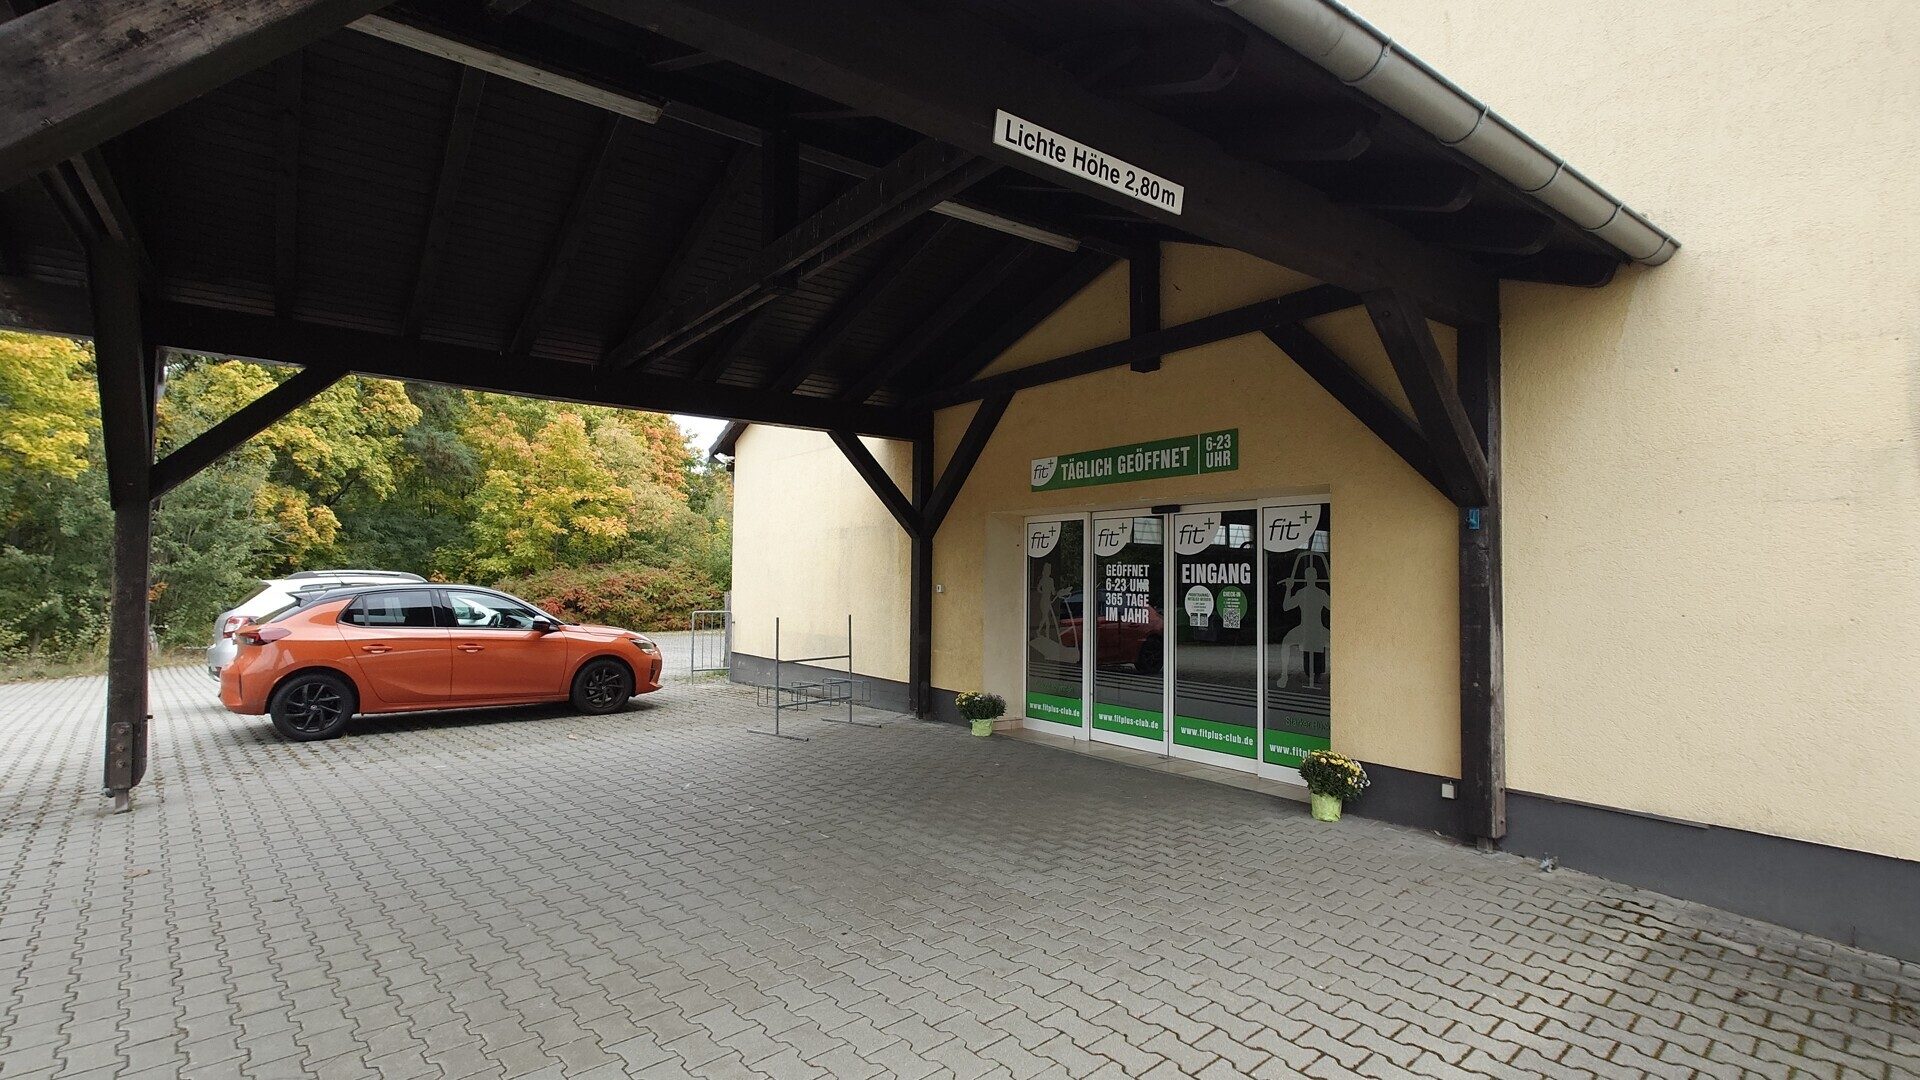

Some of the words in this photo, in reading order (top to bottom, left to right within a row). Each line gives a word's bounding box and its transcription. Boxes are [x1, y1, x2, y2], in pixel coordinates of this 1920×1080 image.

[1005, 119, 1066, 163] Lichte
[1072, 146, 1120, 185] Höhe
[1205, 433, 1232, 451] 6-23
[1061, 458, 1112, 481] TÄGLICH
[1118, 447, 1190, 474] GEÖFFNET
[1205, 450, 1231, 469] UHR
[1105, 562, 1150, 577] GEÖFFNET
[1181, 563, 1250, 584] EINGANG
[1105, 578, 1127, 592] 6-23
[1129, 579, 1150, 593] UHR
[1105, 593, 1123, 606] 365
[1125, 593, 1150, 607] TAGE
[1105, 607, 1118, 622] IM
[1121, 608, 1149, 624] JAHR
[1029, 702, 1080, 718] www.fitplus-club.de
[1098, 713, 1159, 730] www.fitplus-club.de
[1180, 726, 1254, 746] www.fitplus-club.de
[1269, 744, 1311, 759] www.fitpl
